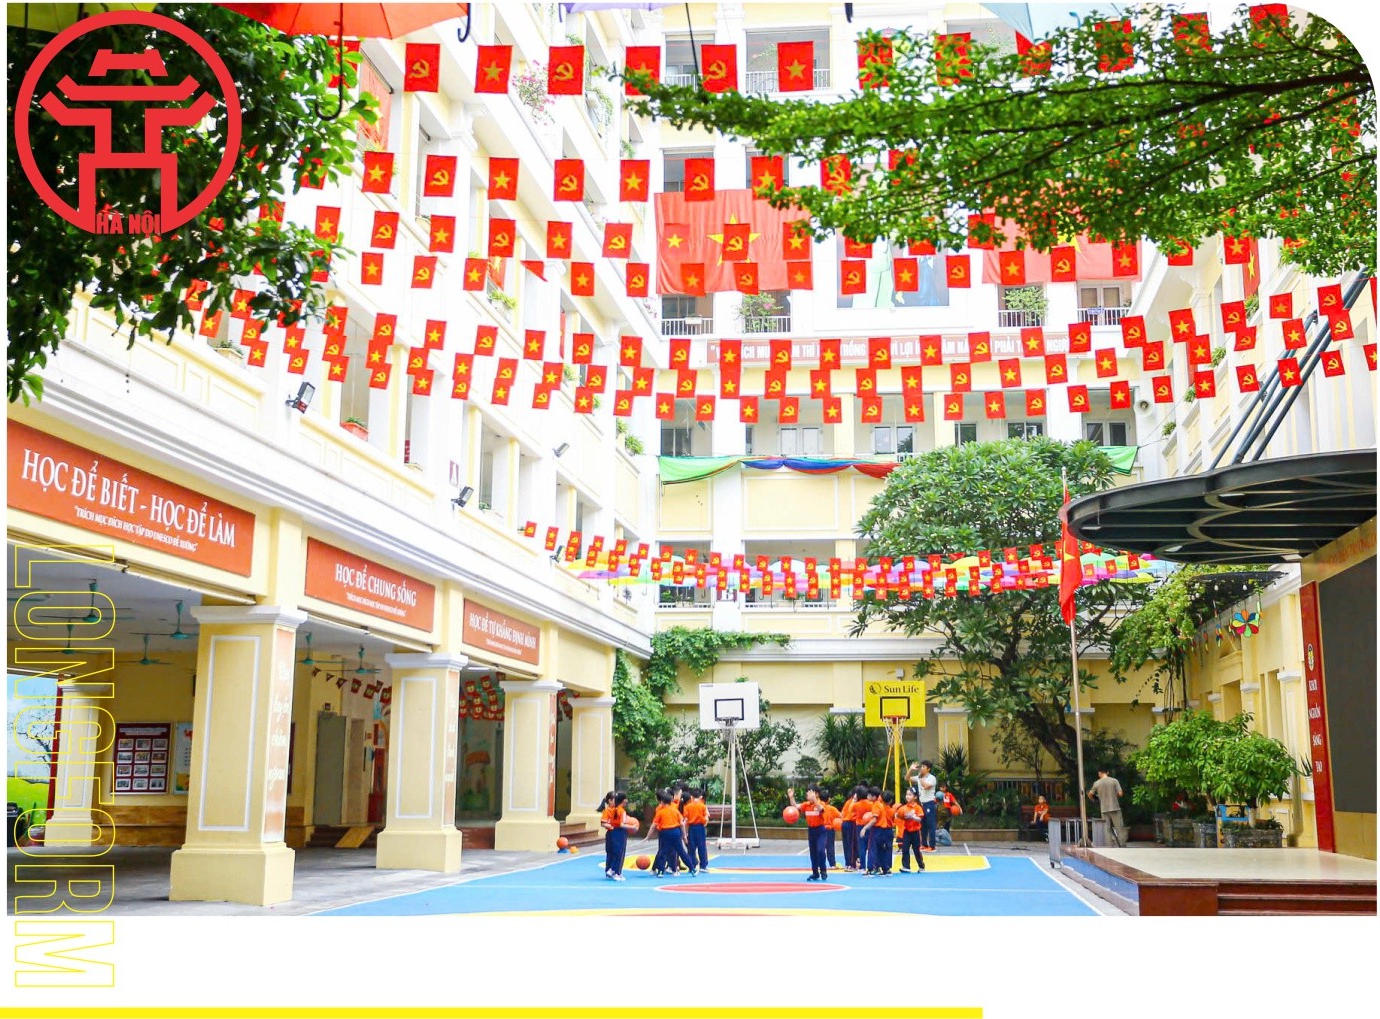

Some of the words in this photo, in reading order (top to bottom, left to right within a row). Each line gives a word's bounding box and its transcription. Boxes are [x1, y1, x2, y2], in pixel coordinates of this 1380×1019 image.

[1046, 336, 1069, 353] NGƯỜ
[22, 448, 69, 493] HỌC
[71, 460, 99, 501] ĐỂ
[100, 473, 140, 515] BIẾT
[150, 494, 186, 532] HỌC
[186, 501, 208, 538] ĐỂ
[208, 512, 236, 548] LÀM
[335, 563, 356, 588] HỌC
[356, 564, 368, 590] ĐỂ
[368, 576, 397, 601] CHUNG
[397, 580, 418, 607] SỐNG
[469, 612, 482, 632] HỌC
[883, 685, 901, 694] Sun
[902, 685, 919, 694] Life
